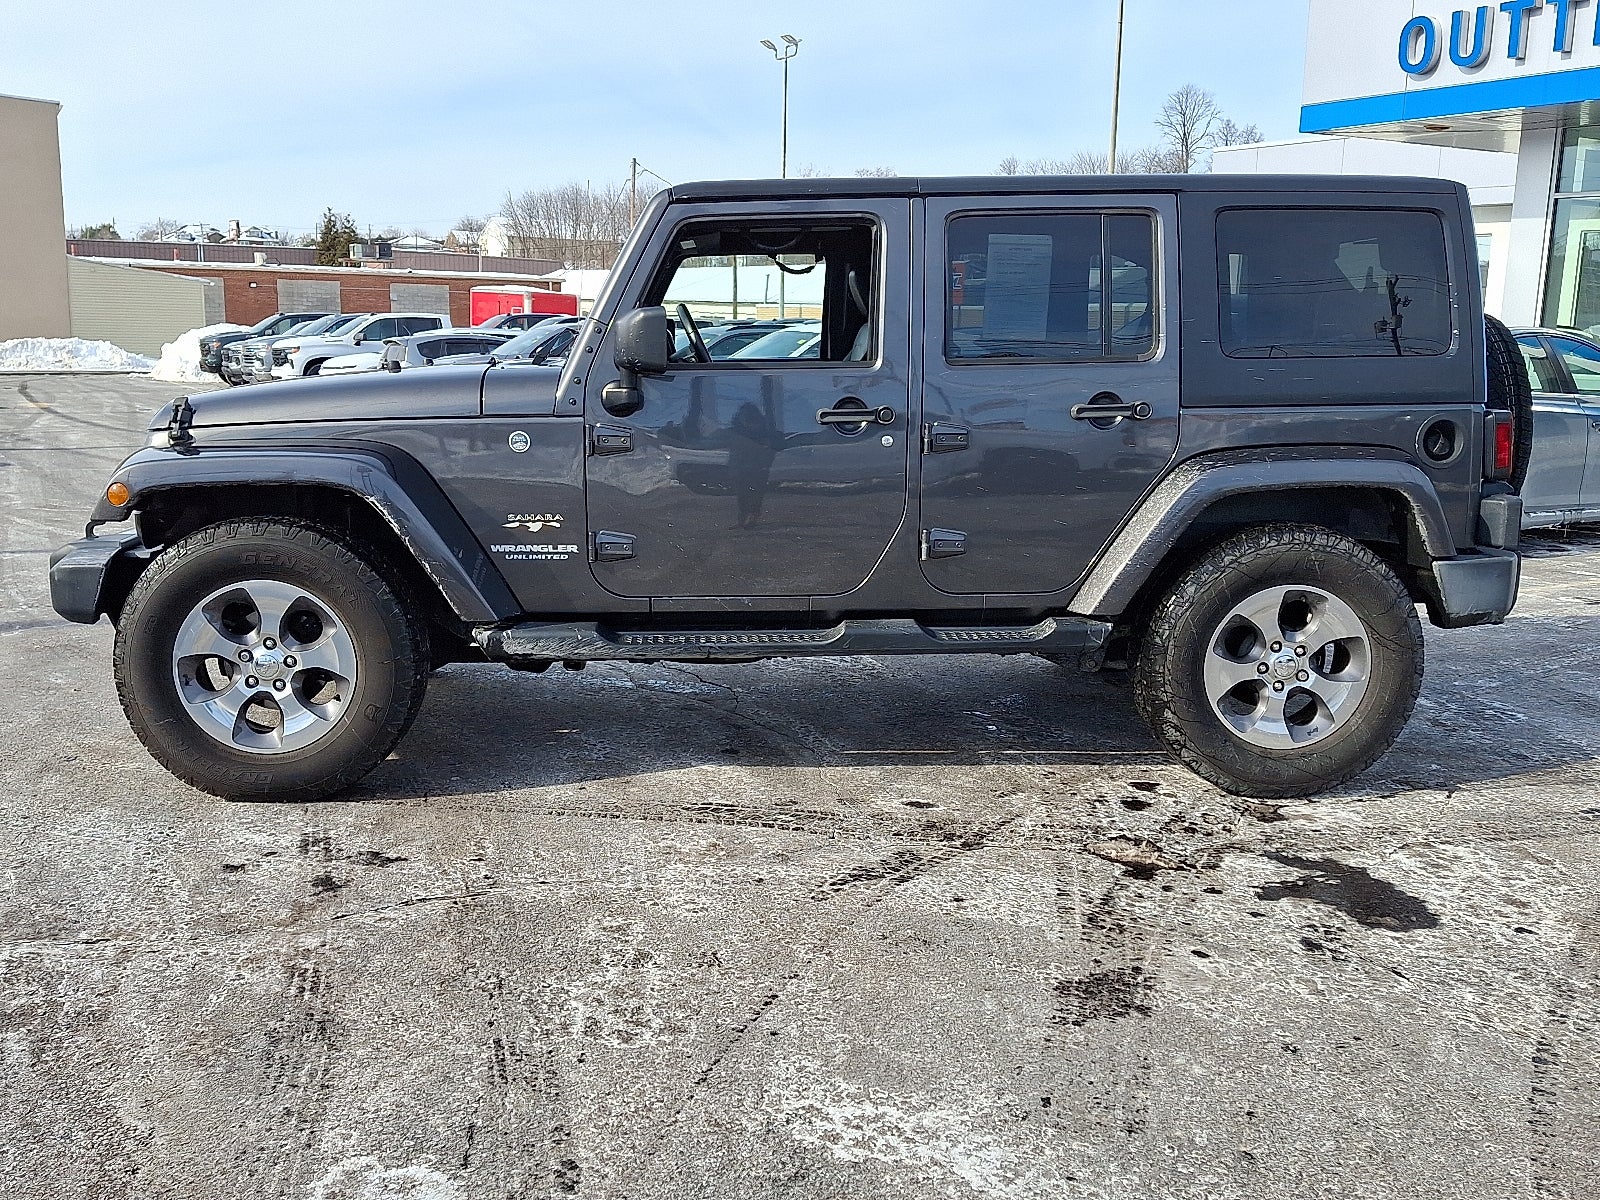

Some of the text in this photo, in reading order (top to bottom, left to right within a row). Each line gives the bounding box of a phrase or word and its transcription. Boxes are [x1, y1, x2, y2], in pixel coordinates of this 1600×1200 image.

[1398, 0, 1600, 76] OUTT
[507, 513, 564, 521] SAHARA
[490, 544, 579, 554] WRANGLER
